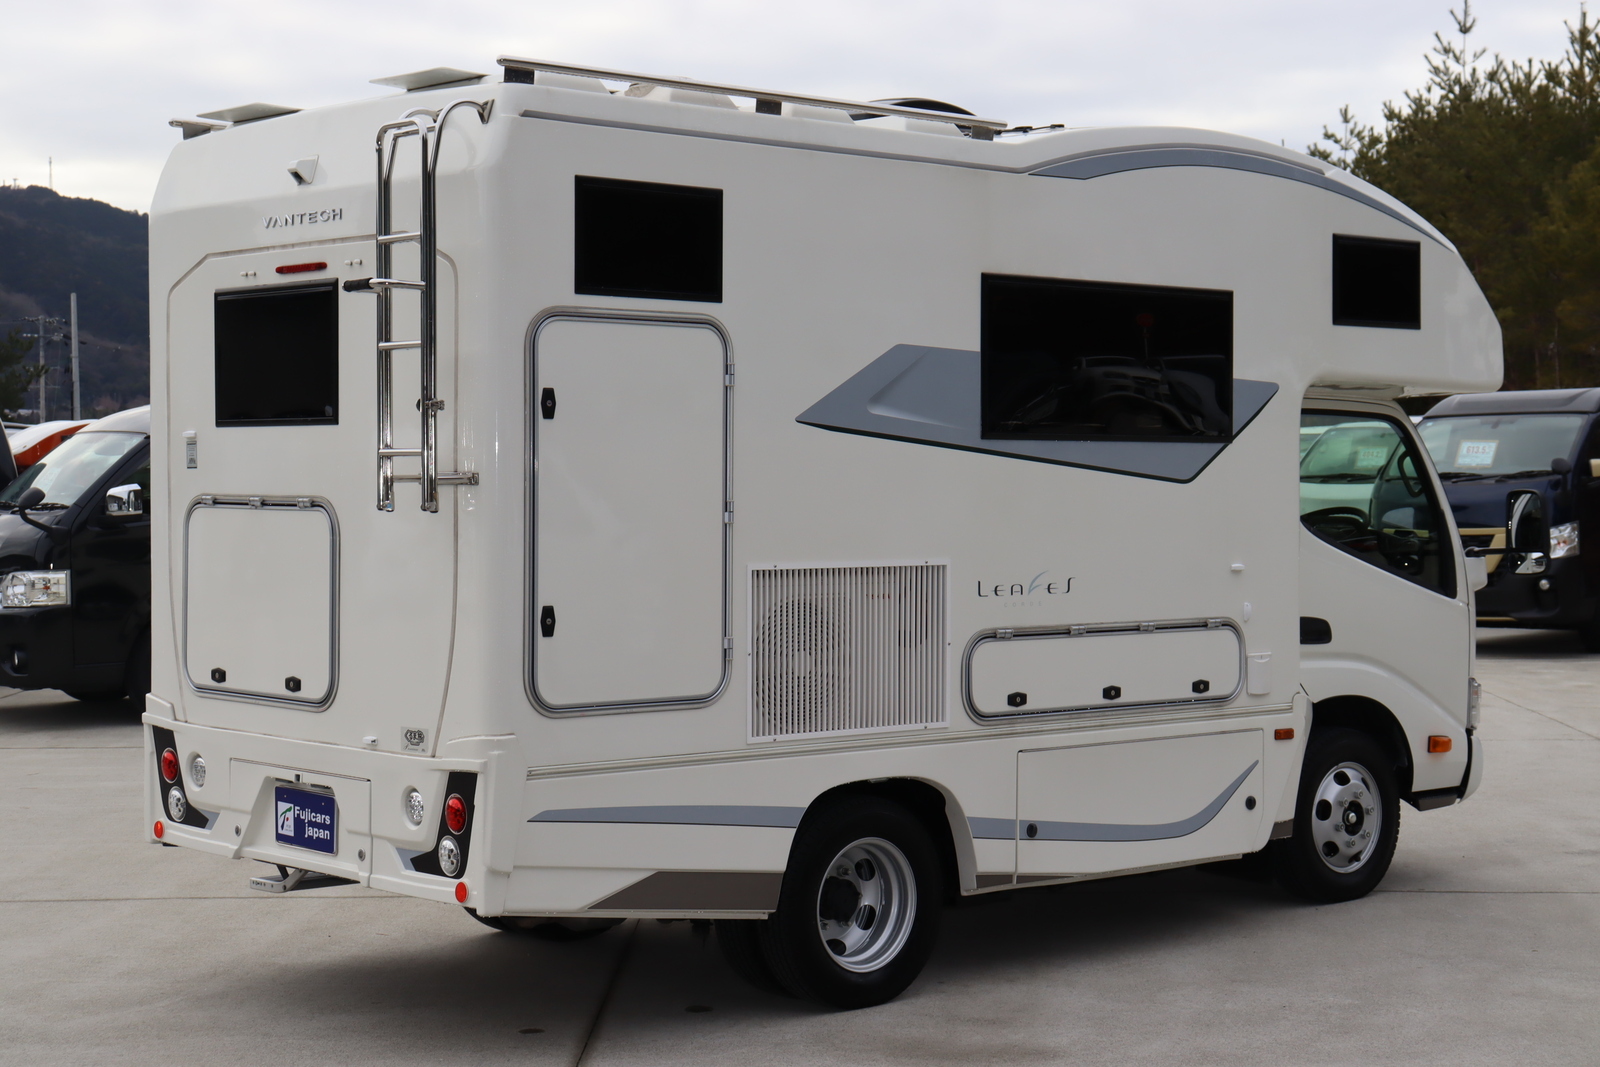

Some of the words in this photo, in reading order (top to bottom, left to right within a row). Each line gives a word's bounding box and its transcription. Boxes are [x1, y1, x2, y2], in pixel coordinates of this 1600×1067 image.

[262, 208, 343, 229] VANTECH
[294, 805, 331, 825] Fujicars
[304, 823, 331, 840] japan
